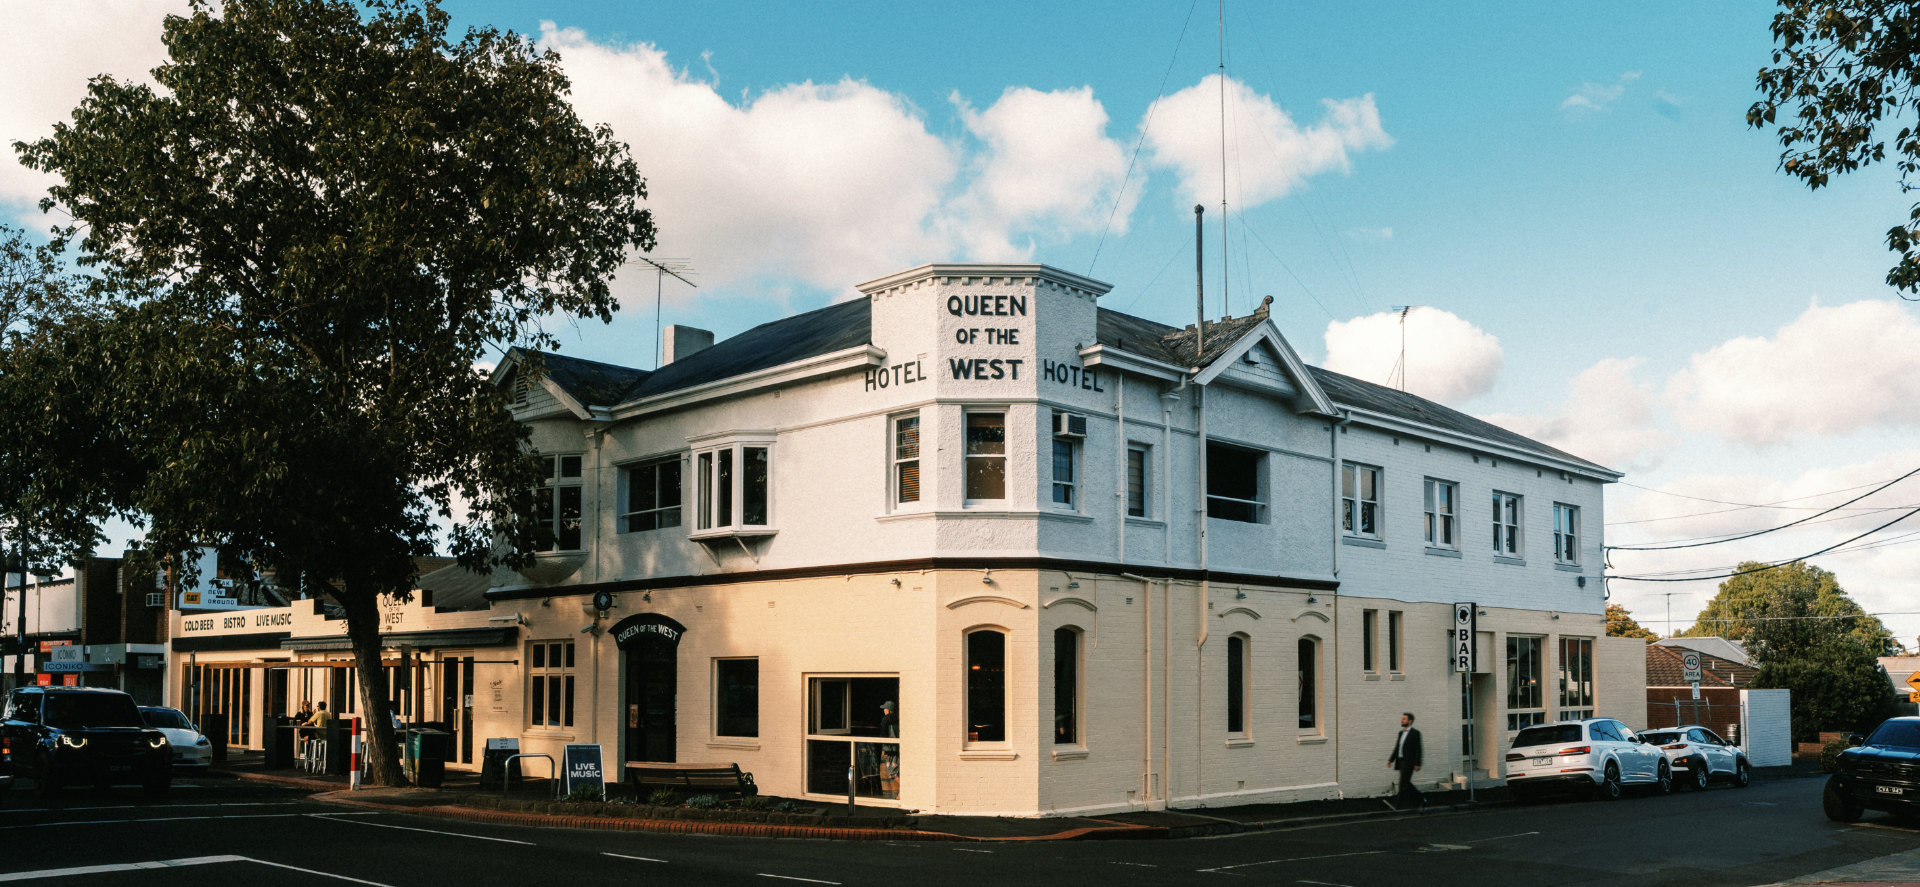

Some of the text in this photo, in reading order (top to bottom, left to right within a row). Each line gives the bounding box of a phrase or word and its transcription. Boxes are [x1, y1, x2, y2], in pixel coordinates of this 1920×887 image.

[947, 295, 1027, 318] QUEEN
[956, 328, 1019, 345] OF THE
[865, 360, 927, 392] HOTEL
[949, 358, 1023, 380] WEST
[1044, 358, 1104, 392] HOTEL
[186, 594, 198, 602] CAT
[184, 619, 214, 632] COLD BEER
[223, 616, 246, 629] BISTRO
[256, 613, 292, 627] LIVE MUSIC
[385, 613, 404, 624] WEST
[618, 624, 679, 642] QUEEN OF THE WEST
[1459, 629, 1469, 668] BAR
[1686, 658, 1698, 666] 40
[570, 770, 601, 778] MUSIC
